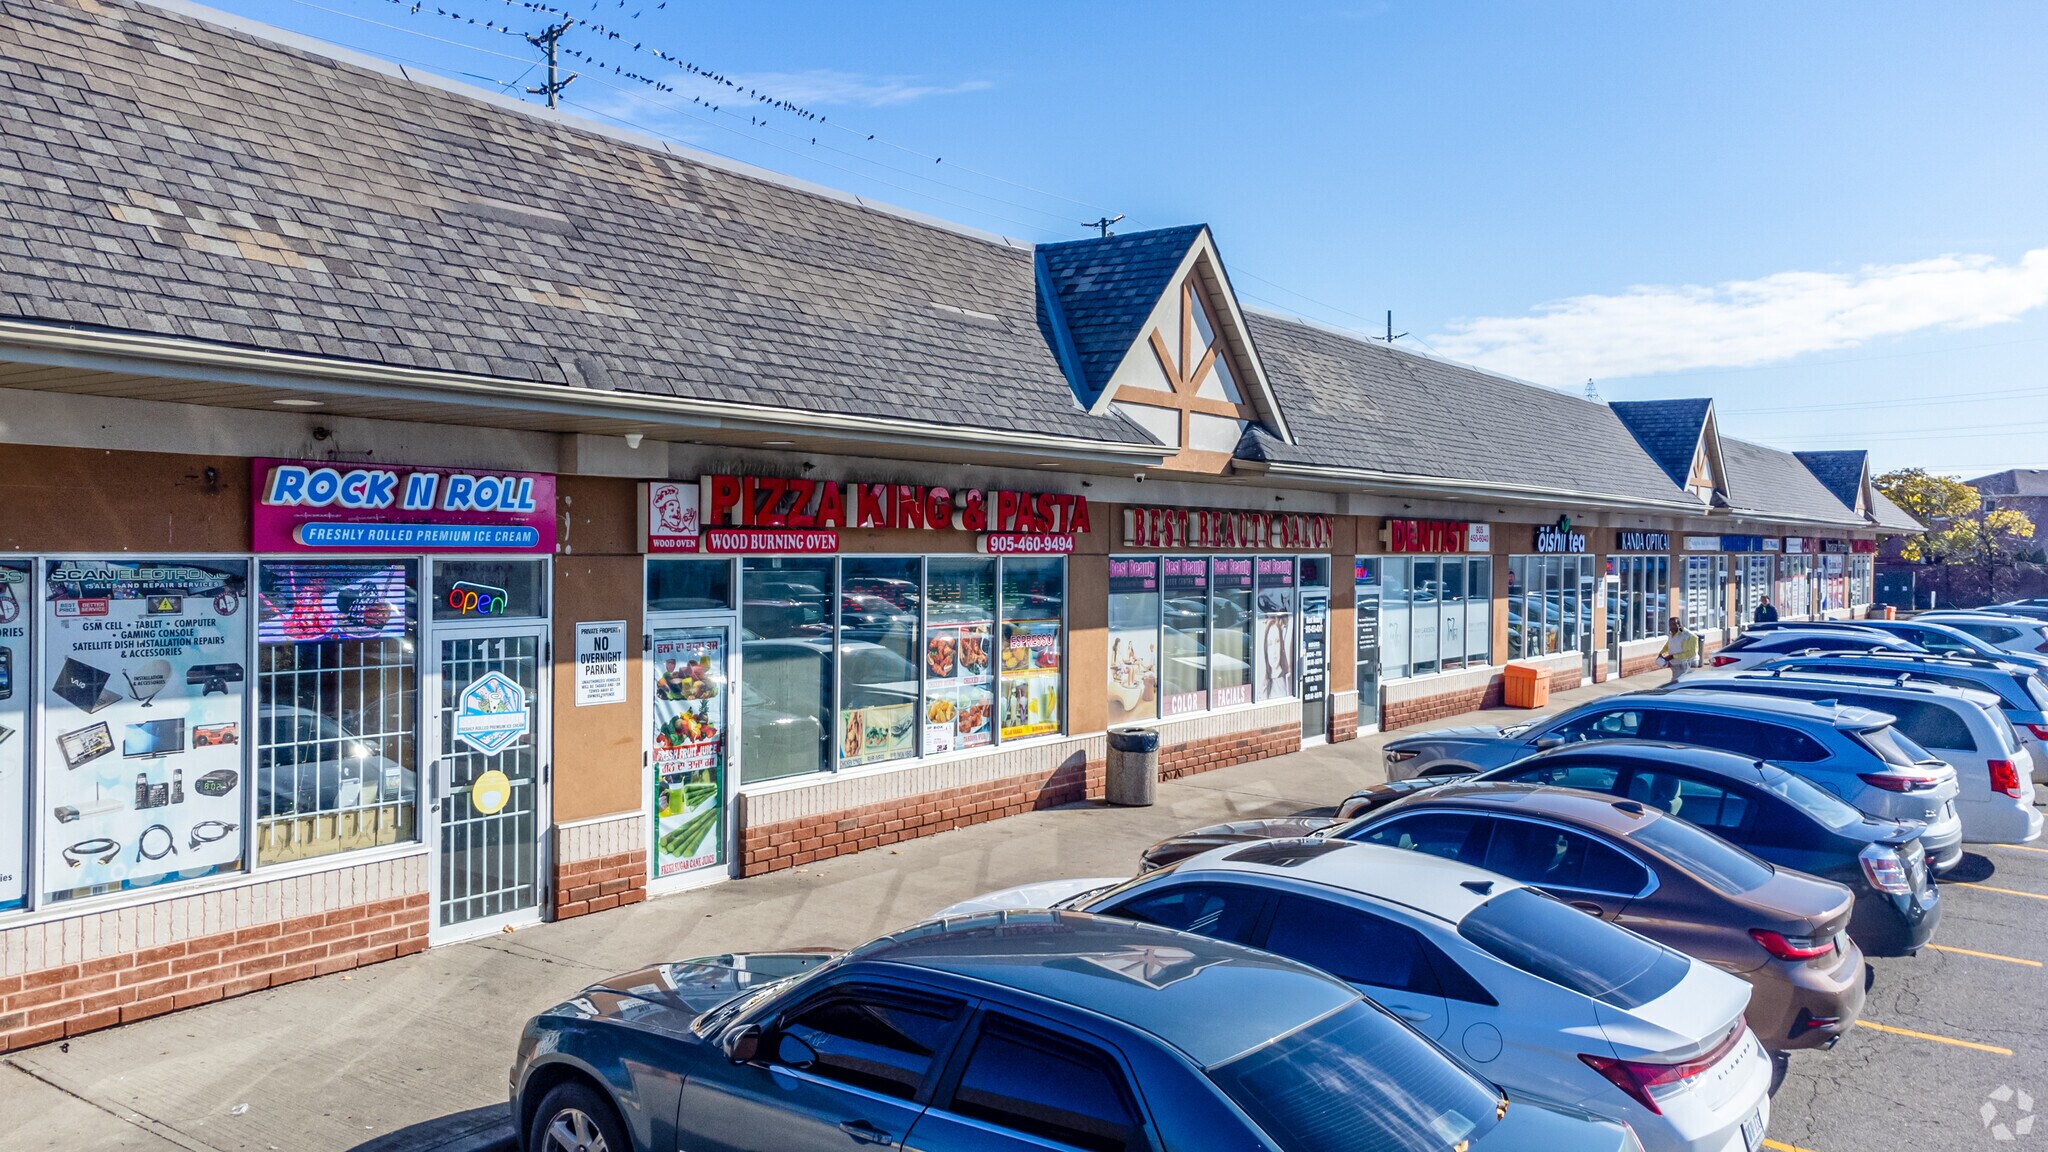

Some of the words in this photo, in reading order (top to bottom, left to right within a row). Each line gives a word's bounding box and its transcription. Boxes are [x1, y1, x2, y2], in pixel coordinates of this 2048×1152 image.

[268, 465, 398, 510] ROCK
[404, 473, 439, 510] N
[444, 474, 537, 513] ROLL
[708, 475, 846, 527] PIZZA
[856, 483, 951, 530] KING
[961, 488, 987, 531] &
[997, 490, 1092, 533] PASTA
[308, 528, 365, 541] FRESHLY
[368, 529, 413, 542] ROLLED
[416, 530, 471, 543] PREMIUM
[473, 531, 492, 543] ICE
[494, 531, 532, 543] CREAM
[1134, 508, 1188, 548] BEST
[1199, 511, 1273, 549] BEAUTY
[1280, 514, 1334, 549] SALON
[1392, 519, 1468, 552] DENTIST
[653, 539, 675, 548] WOOD
[676, 539, 696, 548] OVEN
[710, 533, 748, 549] WOOD
[751, 533, 804, 550] BURNING
[806, 534, 836, 549] OVEN
[990, 535, 1073, 551] 905-460-9494
[1569, 530, 1585, 553] tea
[1622, 532, 1645, 550] KANDA
[1646, 533, 1670, 550] OPTICAL
[52, 568, 114, 581] SCAN
[1110, 559, 1128, 577] Best
[1128, 559, 1156, 578] Beauty
[1165, 558, 1181, 576] Best
[1181, 558, 1206, 577] Beauty
[1214, 558, 1229, 575] Best
[1229, 558, 1251, 576] Beauty
[1258, 559, 1272, 574] Best
[1272, 558, 1292, 576] Beauty
[0, 627, 24, 637] RIES
[82, 622, 103, 631] GSM
[105, 621, 123, 630] CELL
[135, 620, 163, 629] TABLET
[174, 618, 216, 628] COMPUTER
[121, 629, 155, 639] GAMING
[158, 628, 194, 637] CONSOLE
[1010, 633, 1053, 649] ESPRESSO
[73, 641, 112, 651] SATELLITE
[114, 640, 134, 649] DISH
[136, 637, 191, 648] INSTALLATION
[193, 636, 225, 645] REPAIRS
[478, 639, 506, 662] 11
[594, 636, 609, 651] NO
[120, 650, 127, 658] &
[129, 648, 182, 657] ACCESSORIES
[581, 651, 622, 664] OVERNIGHT
[585, 663, 617, 676] PARKING
[70, 677, 86, 689] VAIO
[1171, 693, 1198, 713] COLOR
[1217, 686, 1246, 707] FACIALS
